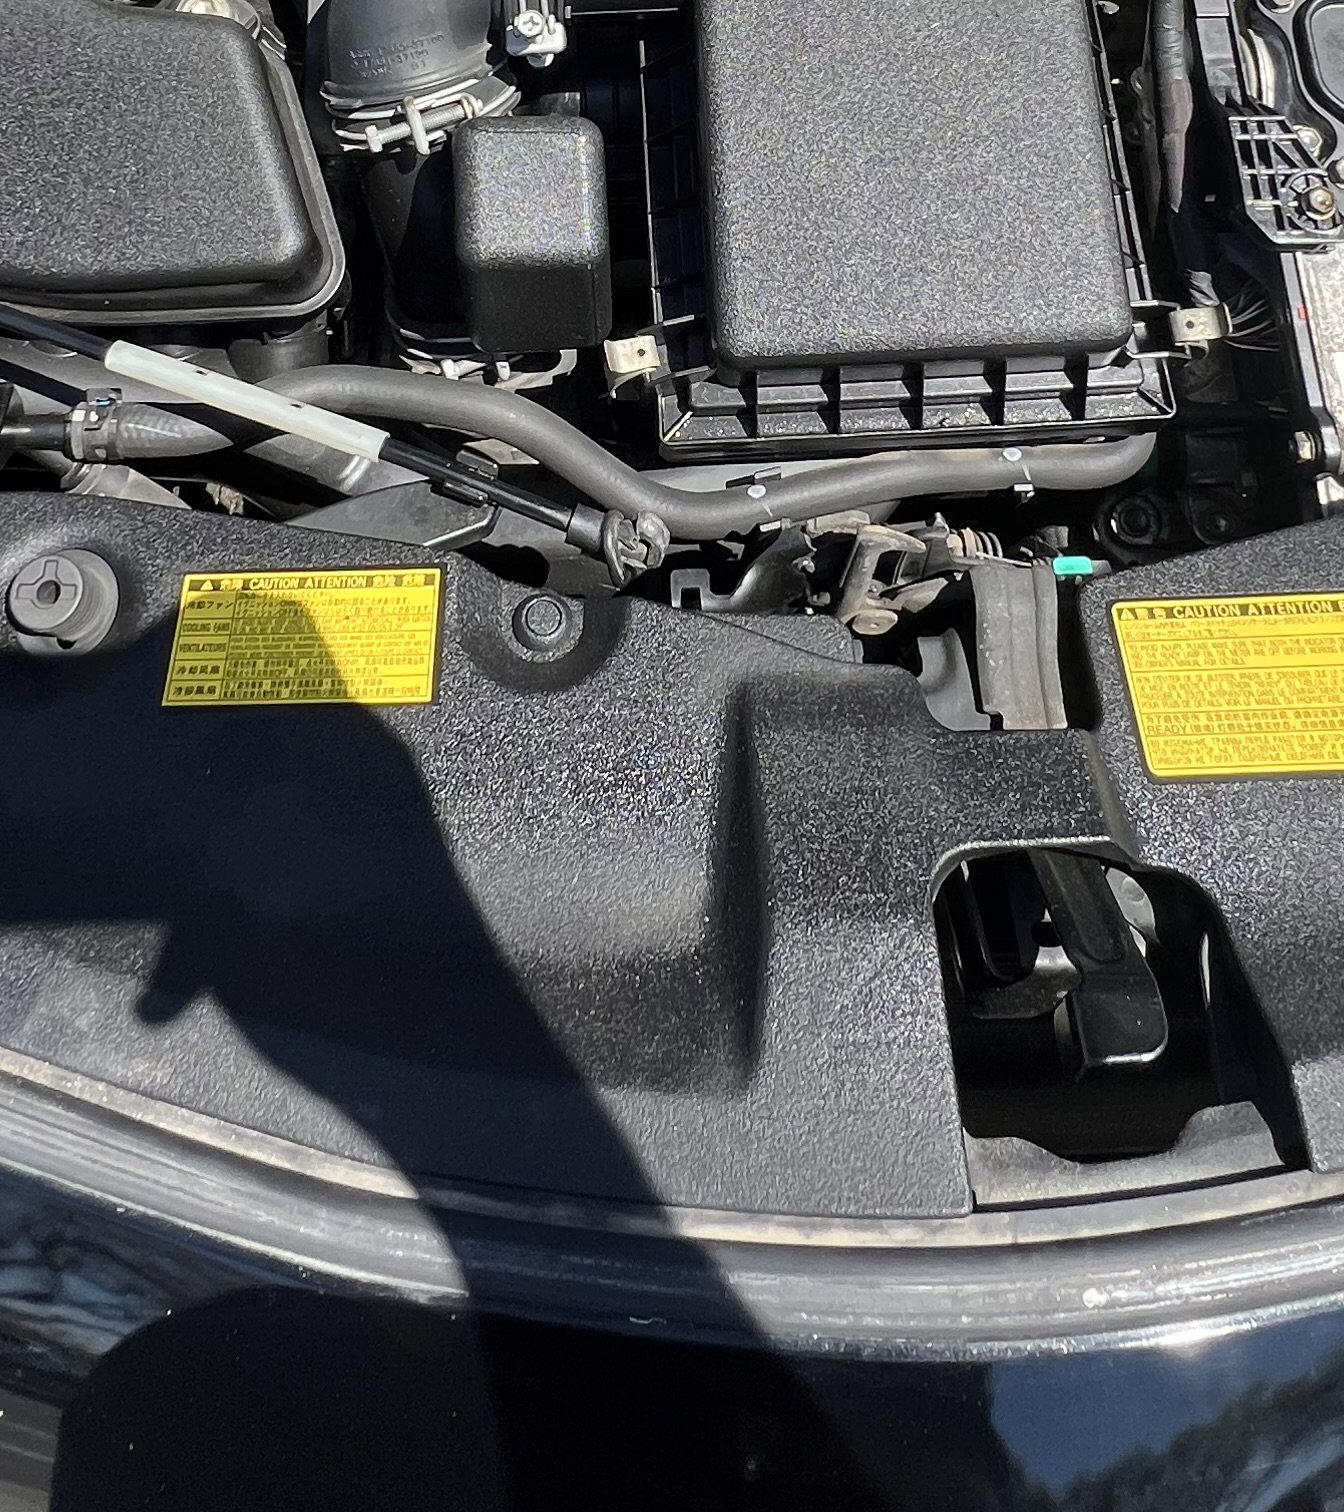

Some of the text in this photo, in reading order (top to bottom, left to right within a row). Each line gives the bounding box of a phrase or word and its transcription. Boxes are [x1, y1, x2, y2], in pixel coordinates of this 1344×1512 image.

[249, 577, 300, 589] CAUTION
[304, 575, 367, 588] ATTENTION
[1173, 603, 1241, 619] CAUTION
[1248, 599, 1333, 616] ATTENTION
